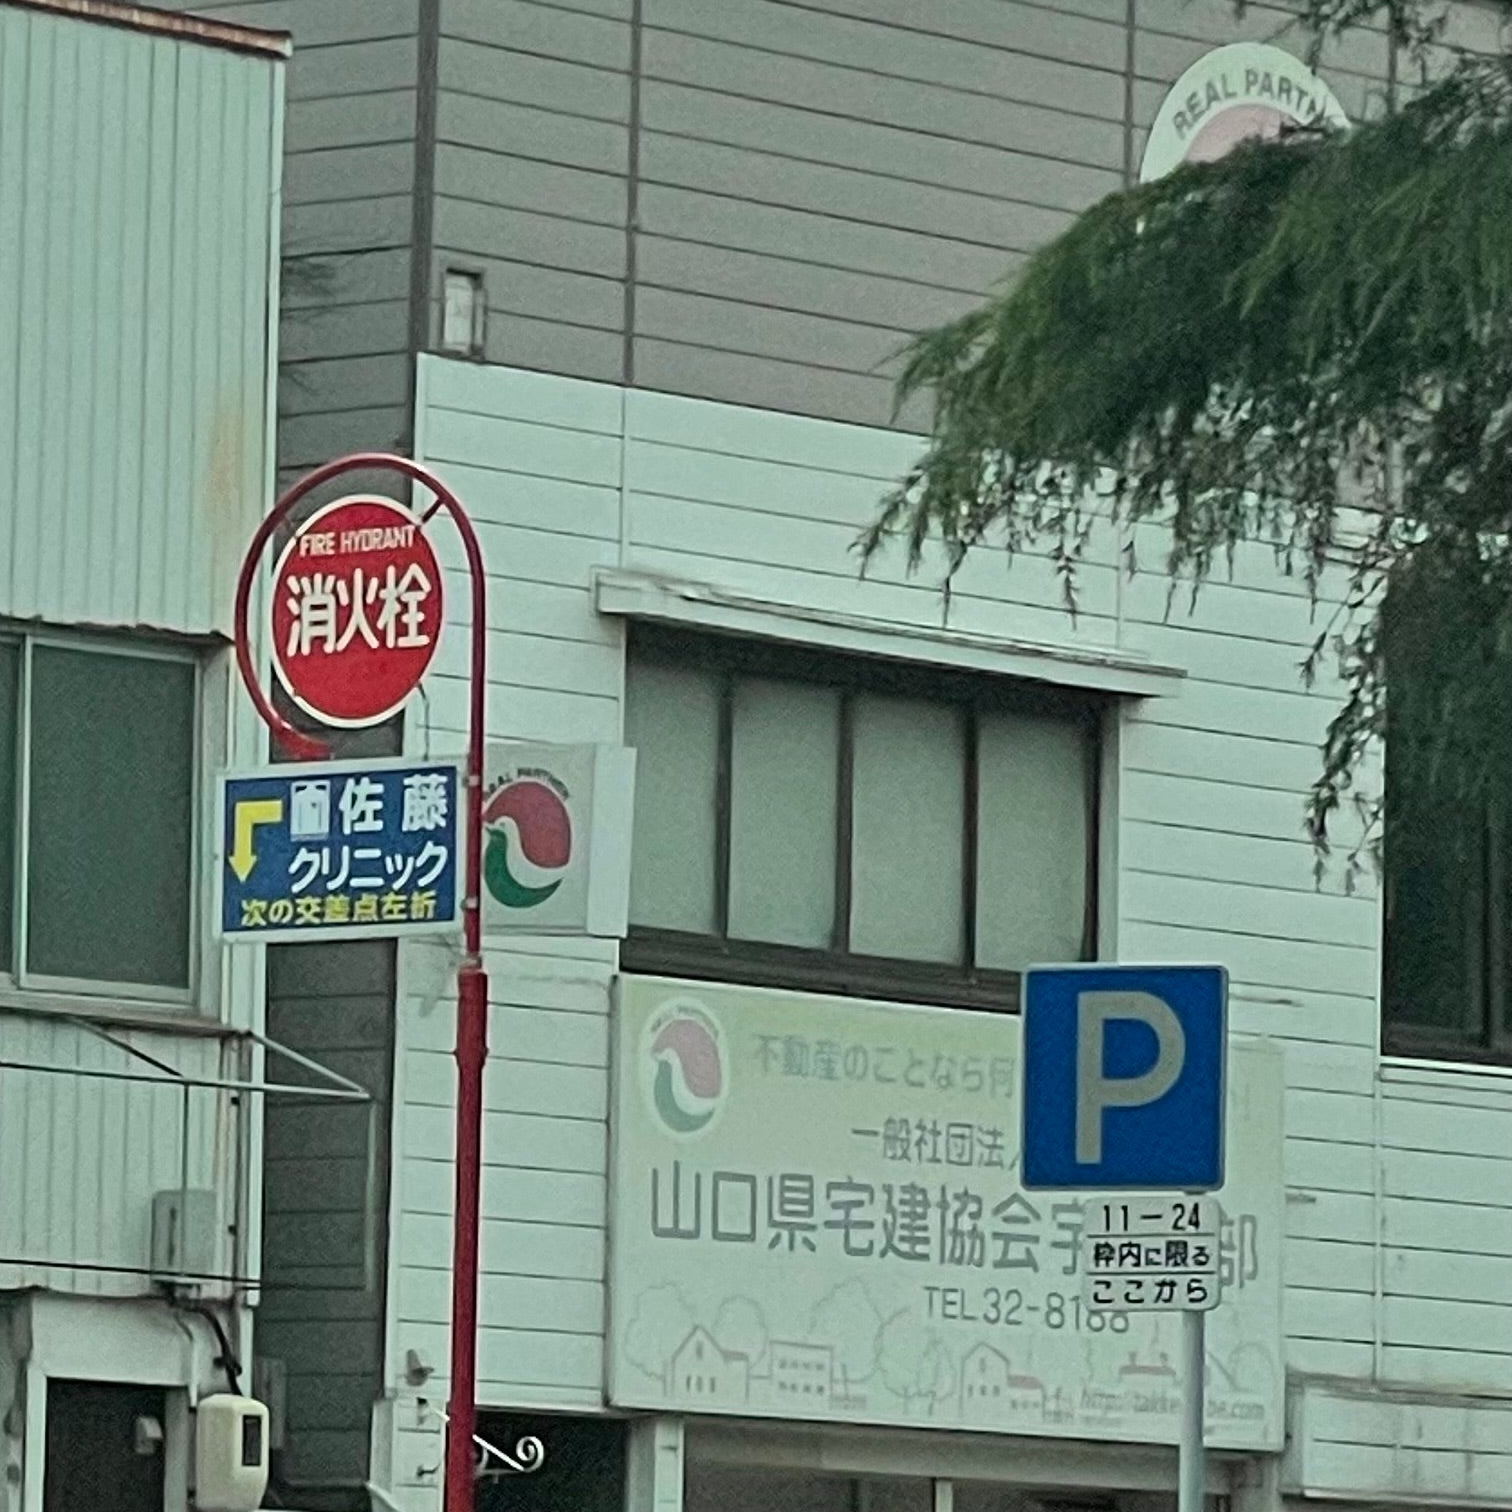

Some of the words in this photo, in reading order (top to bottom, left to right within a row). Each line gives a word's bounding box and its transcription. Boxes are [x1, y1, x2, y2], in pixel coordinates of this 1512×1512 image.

[1173, 73, 1237, 140] REAL
[299, 532, 335, 557] FIRE
[340, 524, 416, 554] HYDRANT
[286, 562, 433, 658] 消火栓
[338, 773, 449, 835] 佐藤
[288, 840, 449, 894] クリニック
[241, 889, 438, 928] 次の交差点左折
[1075, 990, 1187, 1165] P
[1093, 1240, 1210, 1268] 枠内に限る
[1092, 1277, 1209, 1305] ここから
